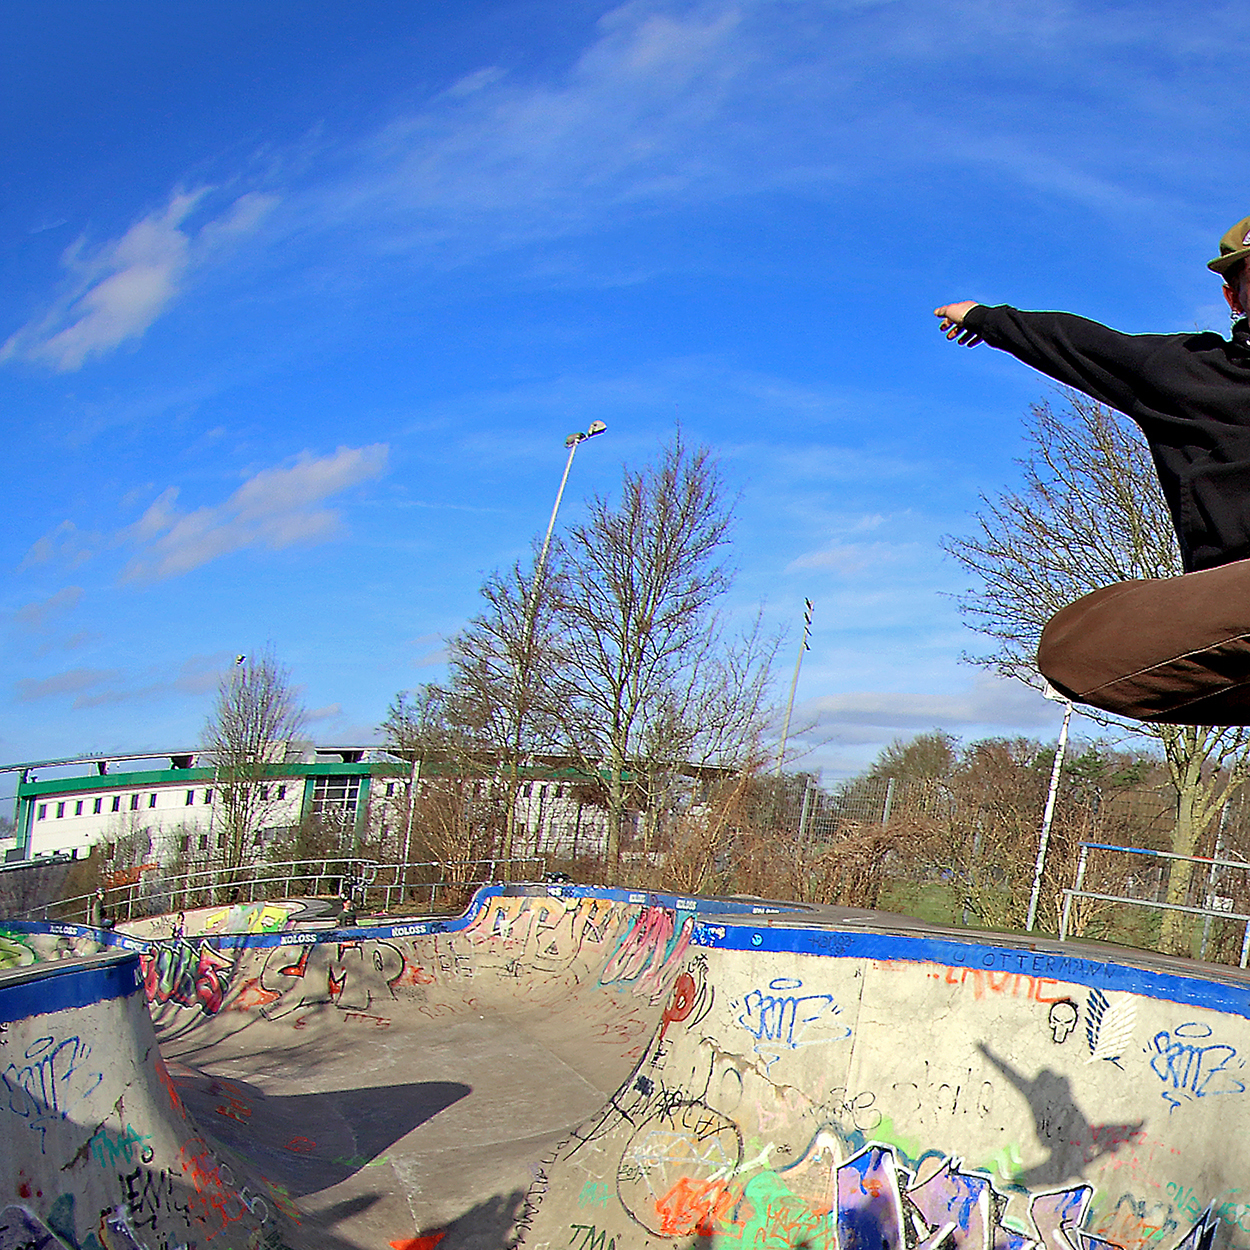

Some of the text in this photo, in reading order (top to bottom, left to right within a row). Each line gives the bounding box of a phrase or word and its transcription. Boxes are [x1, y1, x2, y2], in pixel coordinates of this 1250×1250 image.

[392, 925, 427, 937] KOLOSS
[281, 933, 317, 945] KOLOSS
[982, 953, 1116, 980] OTTERMANN
